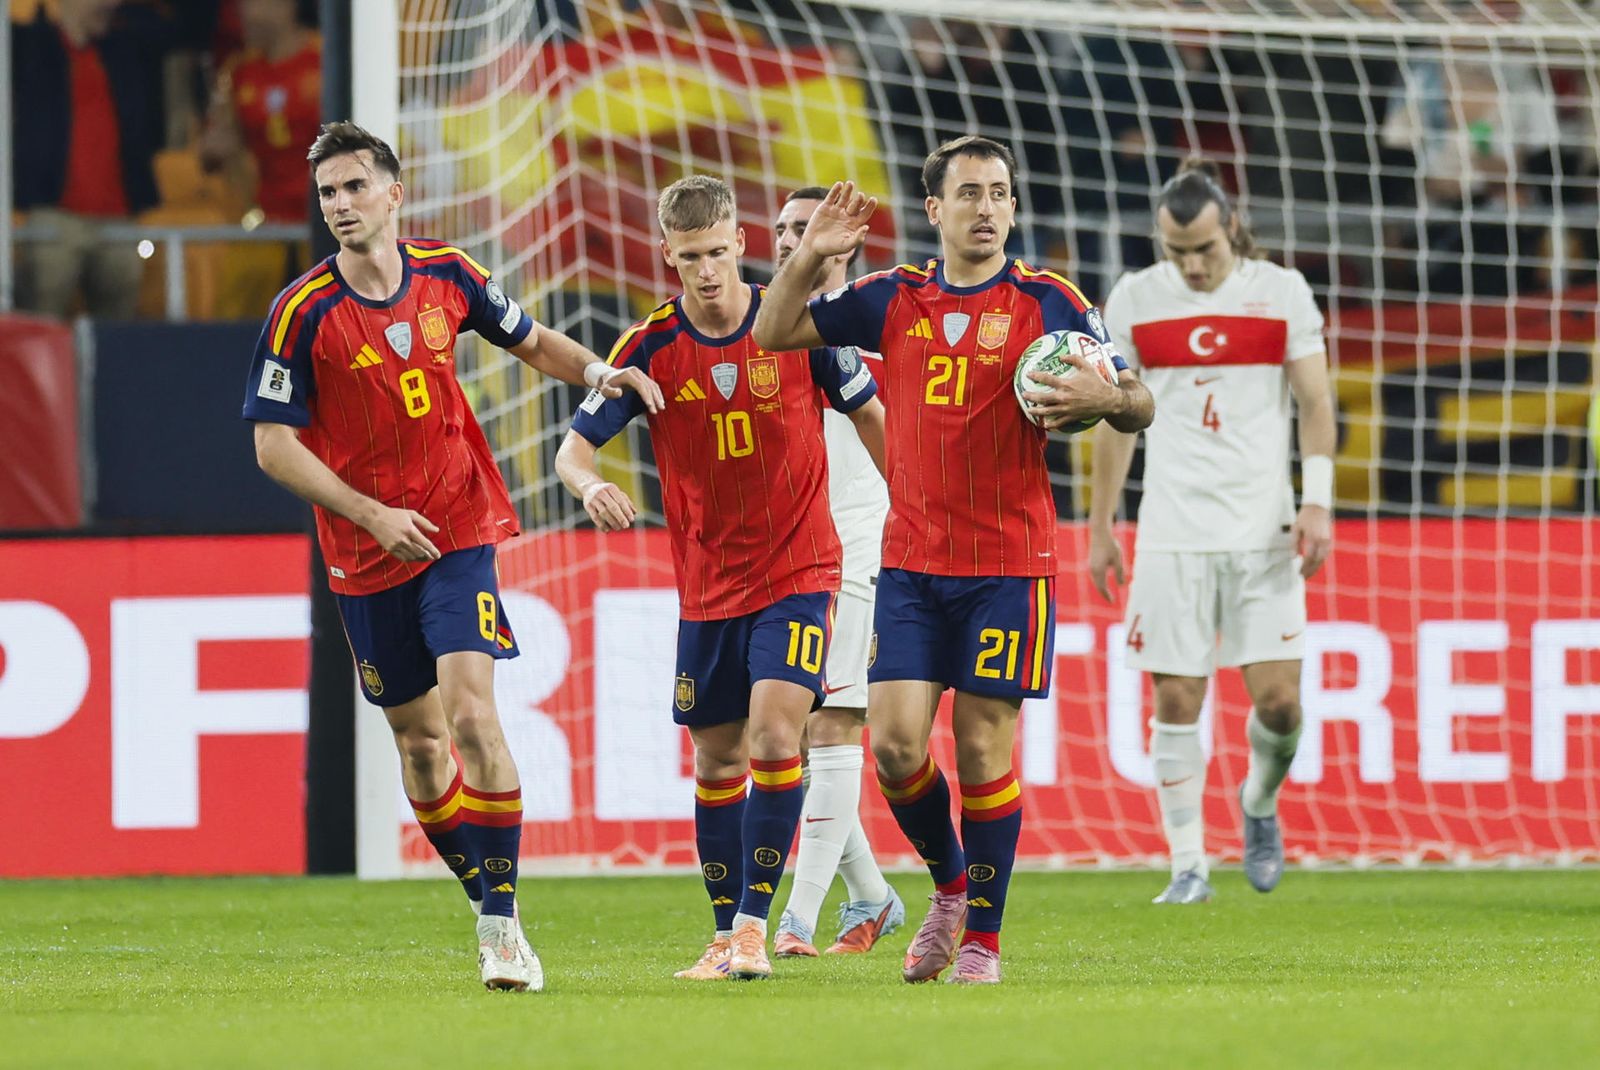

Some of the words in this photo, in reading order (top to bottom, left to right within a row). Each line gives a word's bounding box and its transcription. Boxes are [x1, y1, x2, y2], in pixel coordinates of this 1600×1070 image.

[399, 368, 431, 419] 8
[925, 355, 968, 406] 21
[711, 411, 754, 461] 10
[1202, 393, 1220, 432] 4
[476, 591, 497, 642] 8
[1126, 613, 1144, 652] 4
[786, 621, 824, 675] 10
[974, 628, 1021, 681] 21
